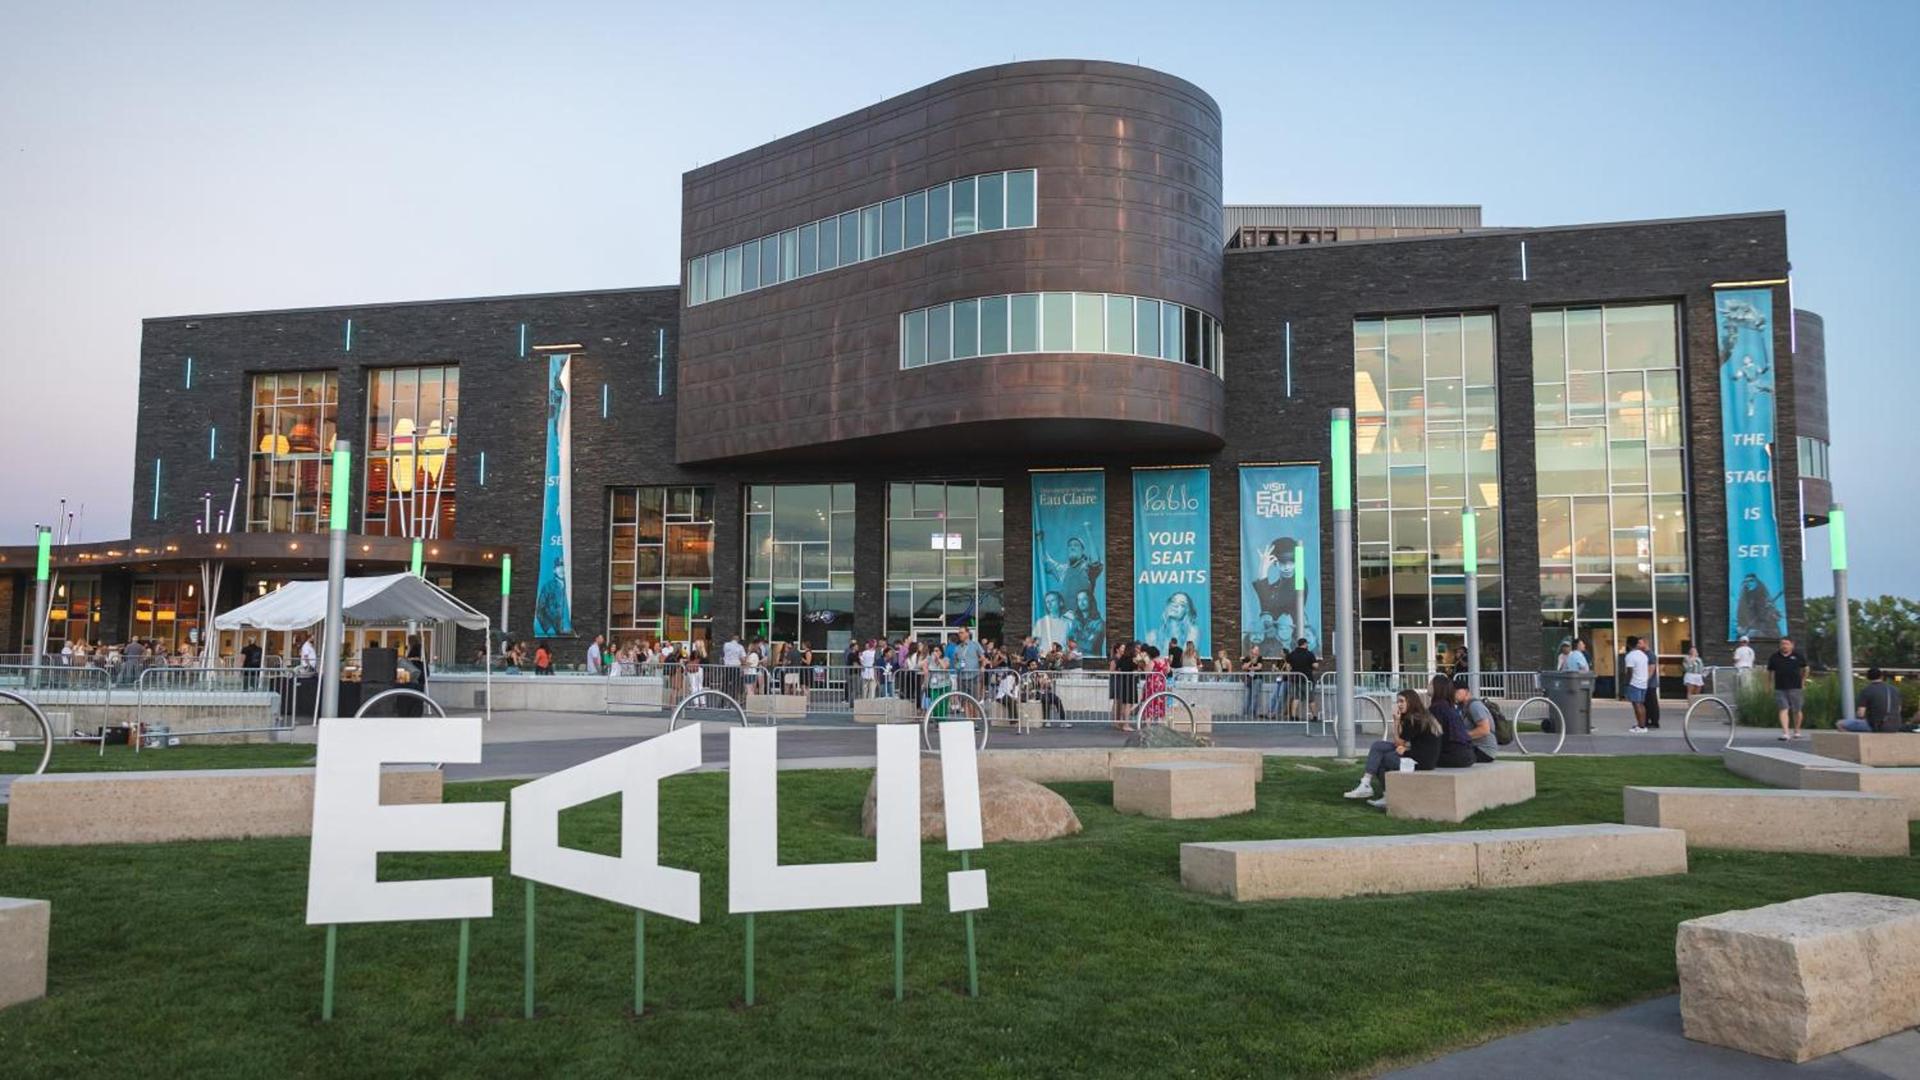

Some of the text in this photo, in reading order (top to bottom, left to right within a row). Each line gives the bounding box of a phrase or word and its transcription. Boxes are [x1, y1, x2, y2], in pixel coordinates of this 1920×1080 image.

[1732, 433, 1765, 446] THE
[1262, 482, 1287, 491] VISIT
[1040, 492, 1096, 505] Eau Claire
[1144, 484, 1199, 511] Pablo
[1256, 489, 1303, 504] EAU
[1256, 504, 1303, 518] CLAIRE
[1744, 507, 1761, 520] IS
[1149, 531, 1196, 546] YOUR
[1151, 550, 1194, 565] SEAT
[1737, 544, 1770, 558] SET
[1138, 570, 1207, 584] AWAITS
[306, 717, 988, 925] EAU!
